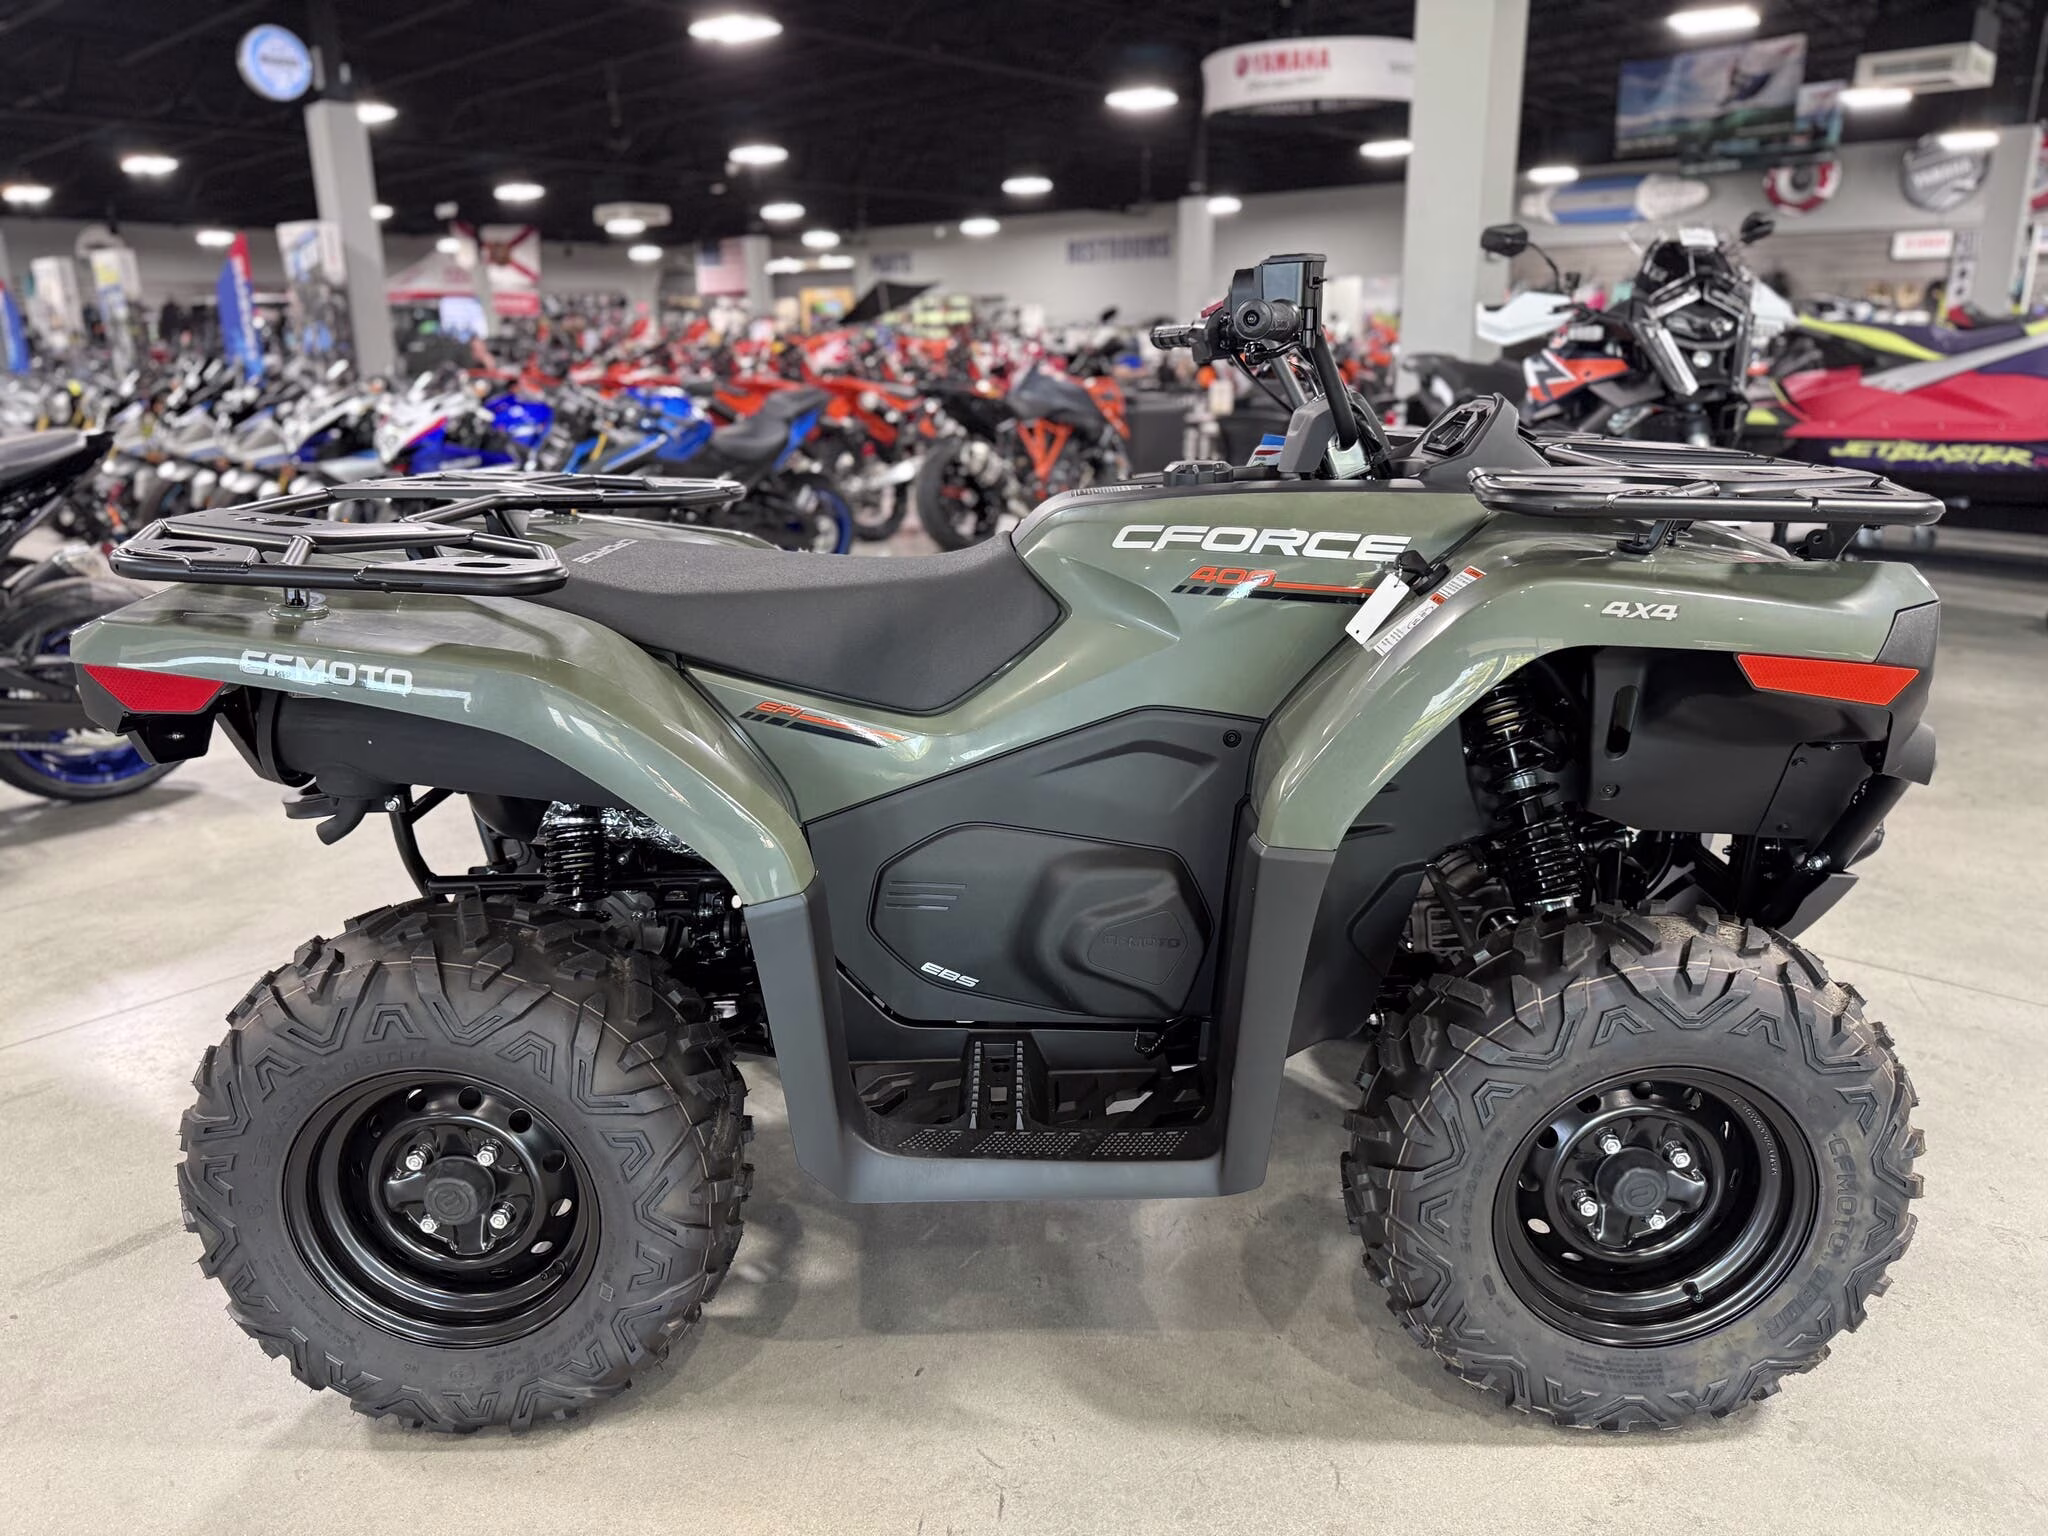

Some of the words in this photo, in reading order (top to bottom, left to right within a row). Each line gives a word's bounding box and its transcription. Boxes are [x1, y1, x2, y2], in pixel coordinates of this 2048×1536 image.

[1111, 524, 1412, 562] CFORCE
[1189, 565, 1278, 587] 400
[1601, 601, 1678, 621] 4X4
[239, 650, 413, 694] CFMOTO
[756, 701, 804, 719] EFI
[920, 962, 980, 988] EBS
